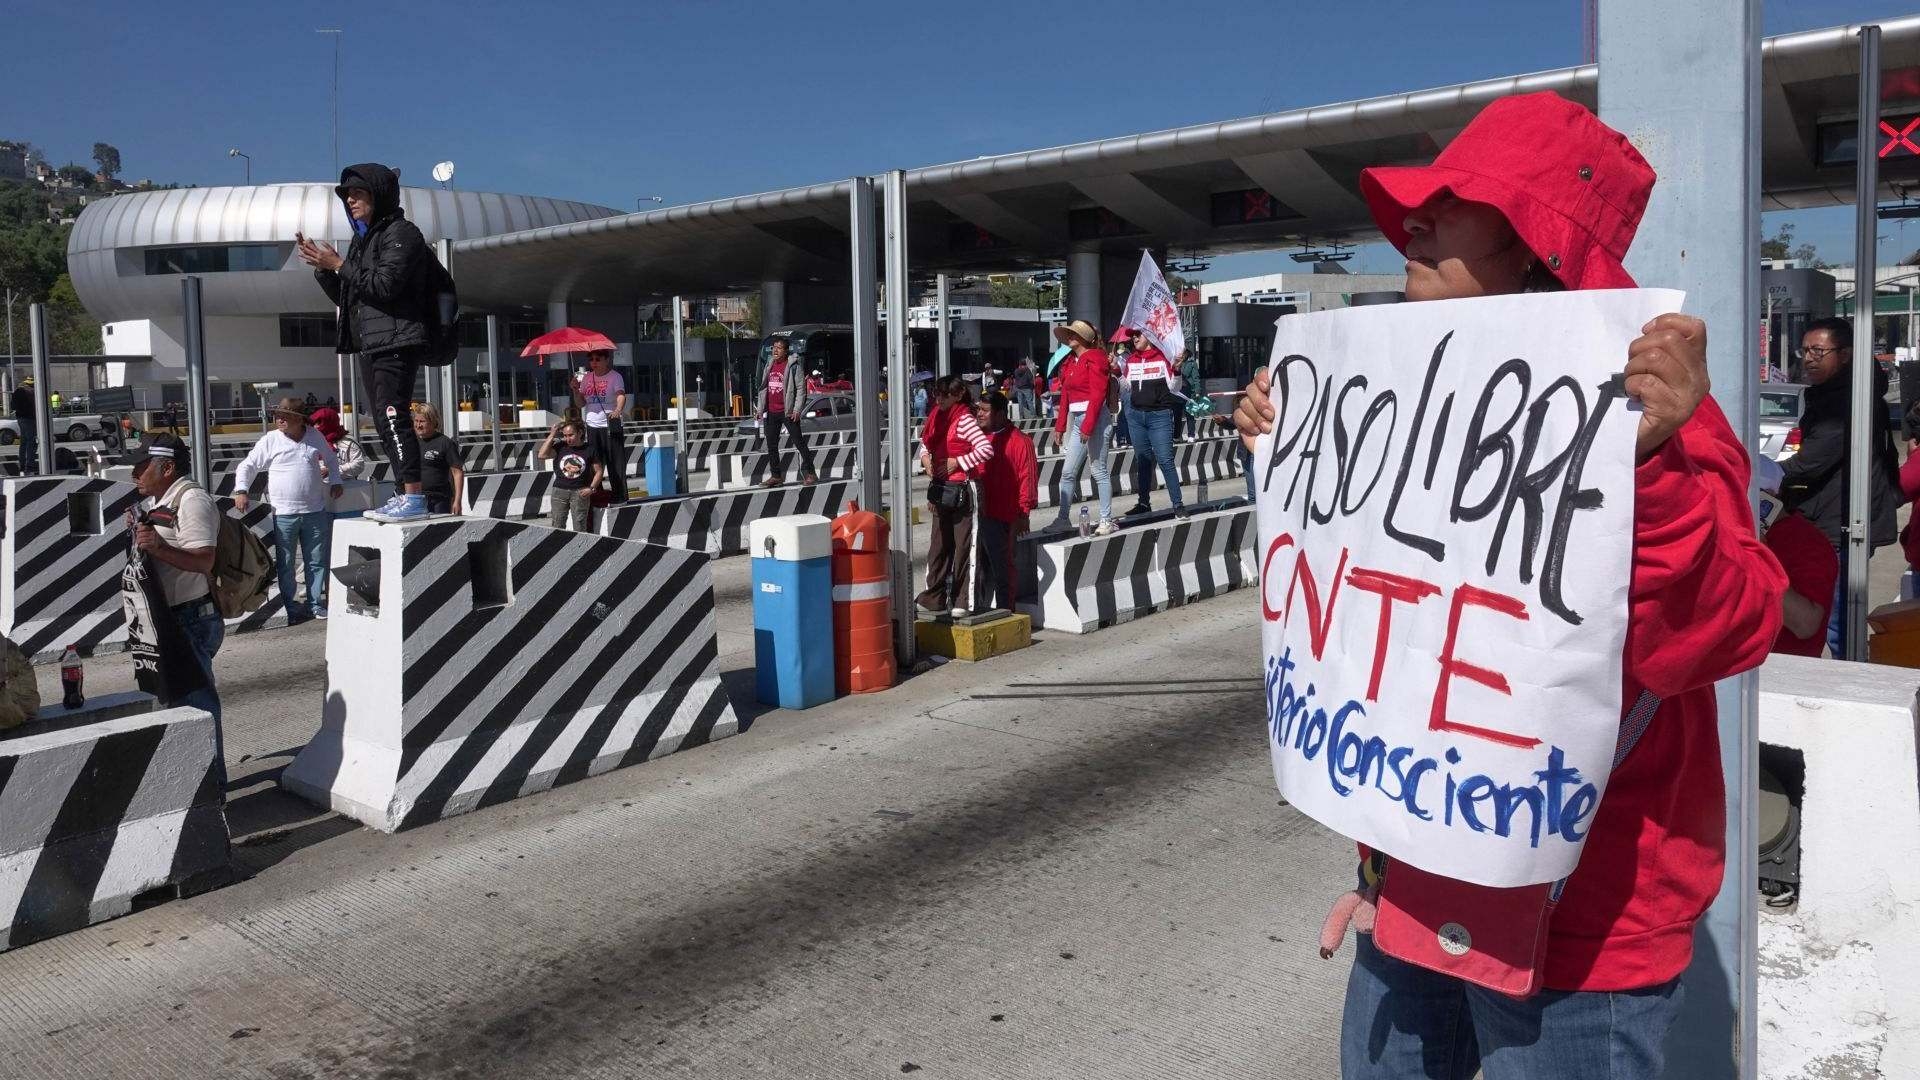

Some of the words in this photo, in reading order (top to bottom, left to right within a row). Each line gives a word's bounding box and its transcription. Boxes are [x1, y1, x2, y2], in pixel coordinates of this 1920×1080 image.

[1264, 354, 1396, 529] PASO
[1383, 330, 1626, 626] LIBRE
[1262, 532, 1544, 750] CNTE
[1327, 699, 1598, 849] Consciente
